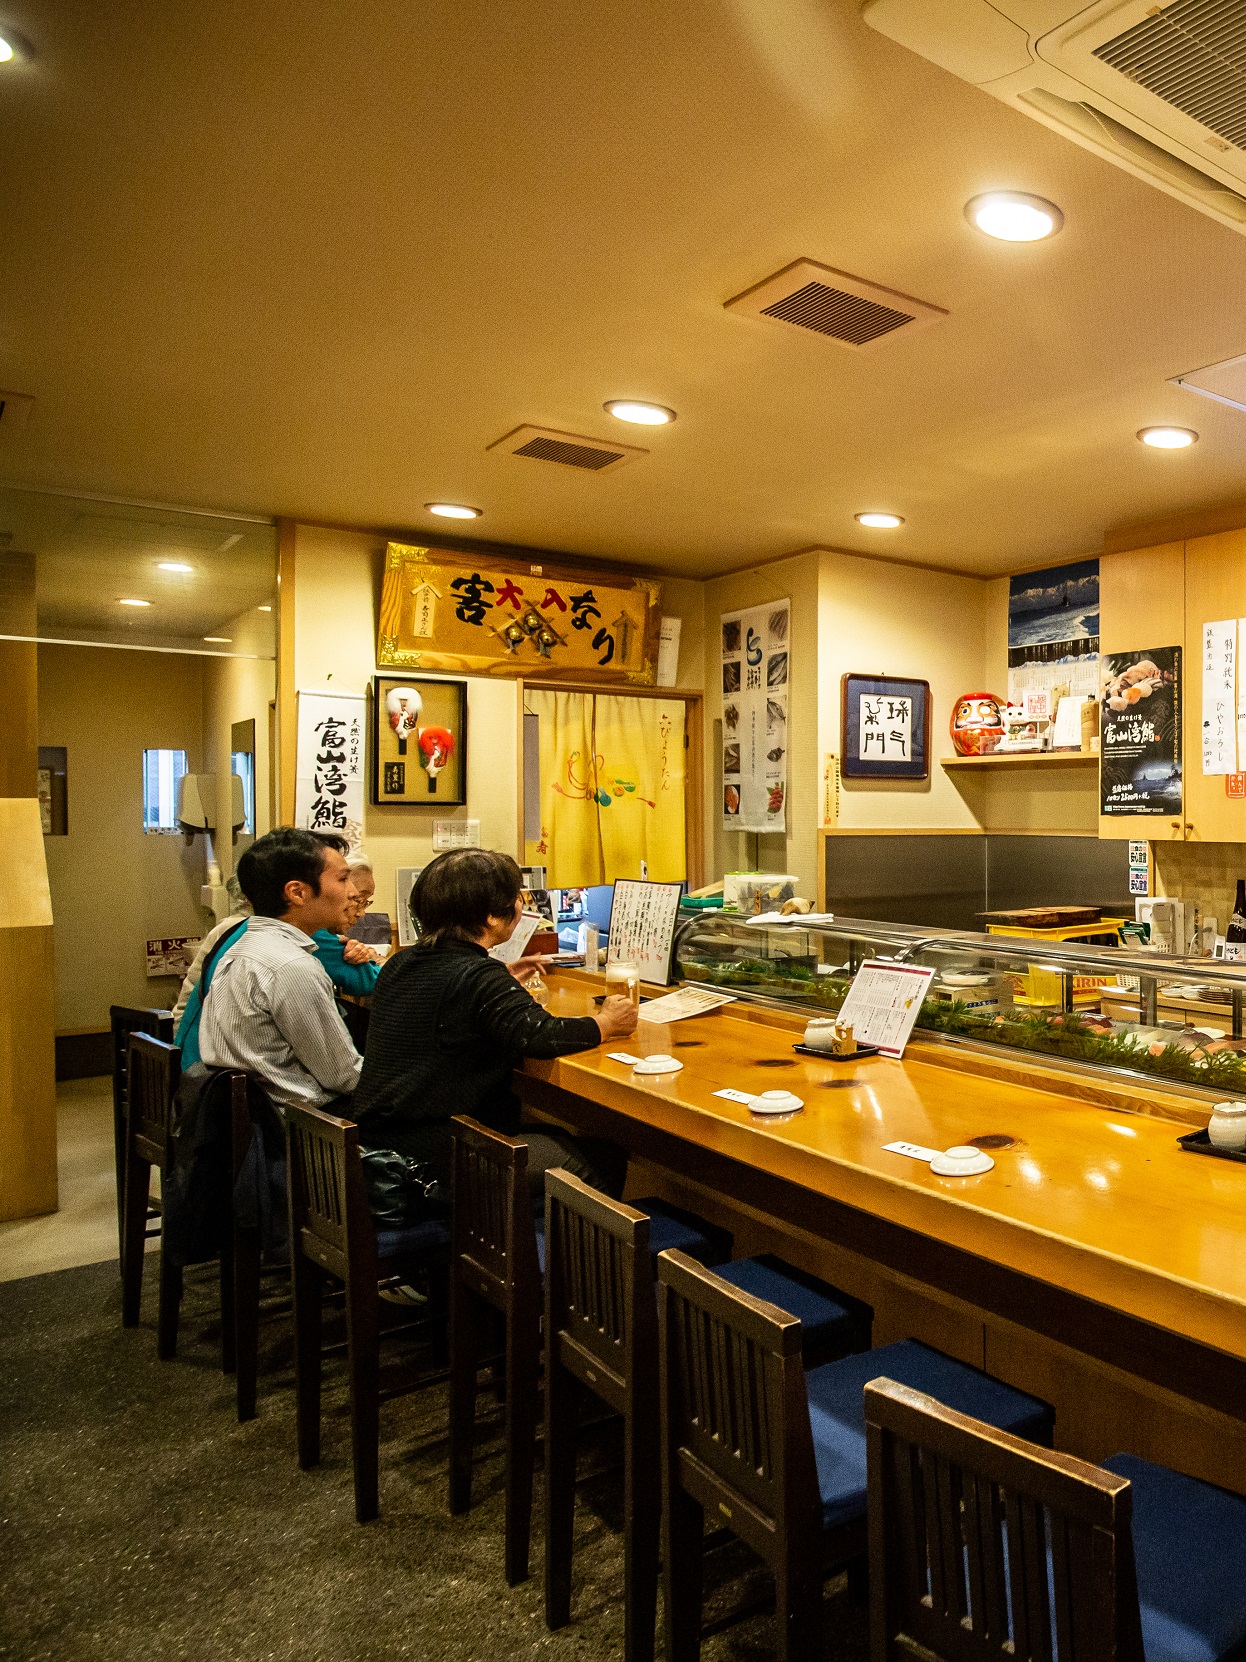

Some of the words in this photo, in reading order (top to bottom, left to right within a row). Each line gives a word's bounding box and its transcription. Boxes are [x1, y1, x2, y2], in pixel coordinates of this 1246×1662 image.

[1104, 720, 1155, 744] 富山湾鮨
[311, 716, 349, 831] 富山湾鮨
[1073, 978, 1107, 988] IRIN
